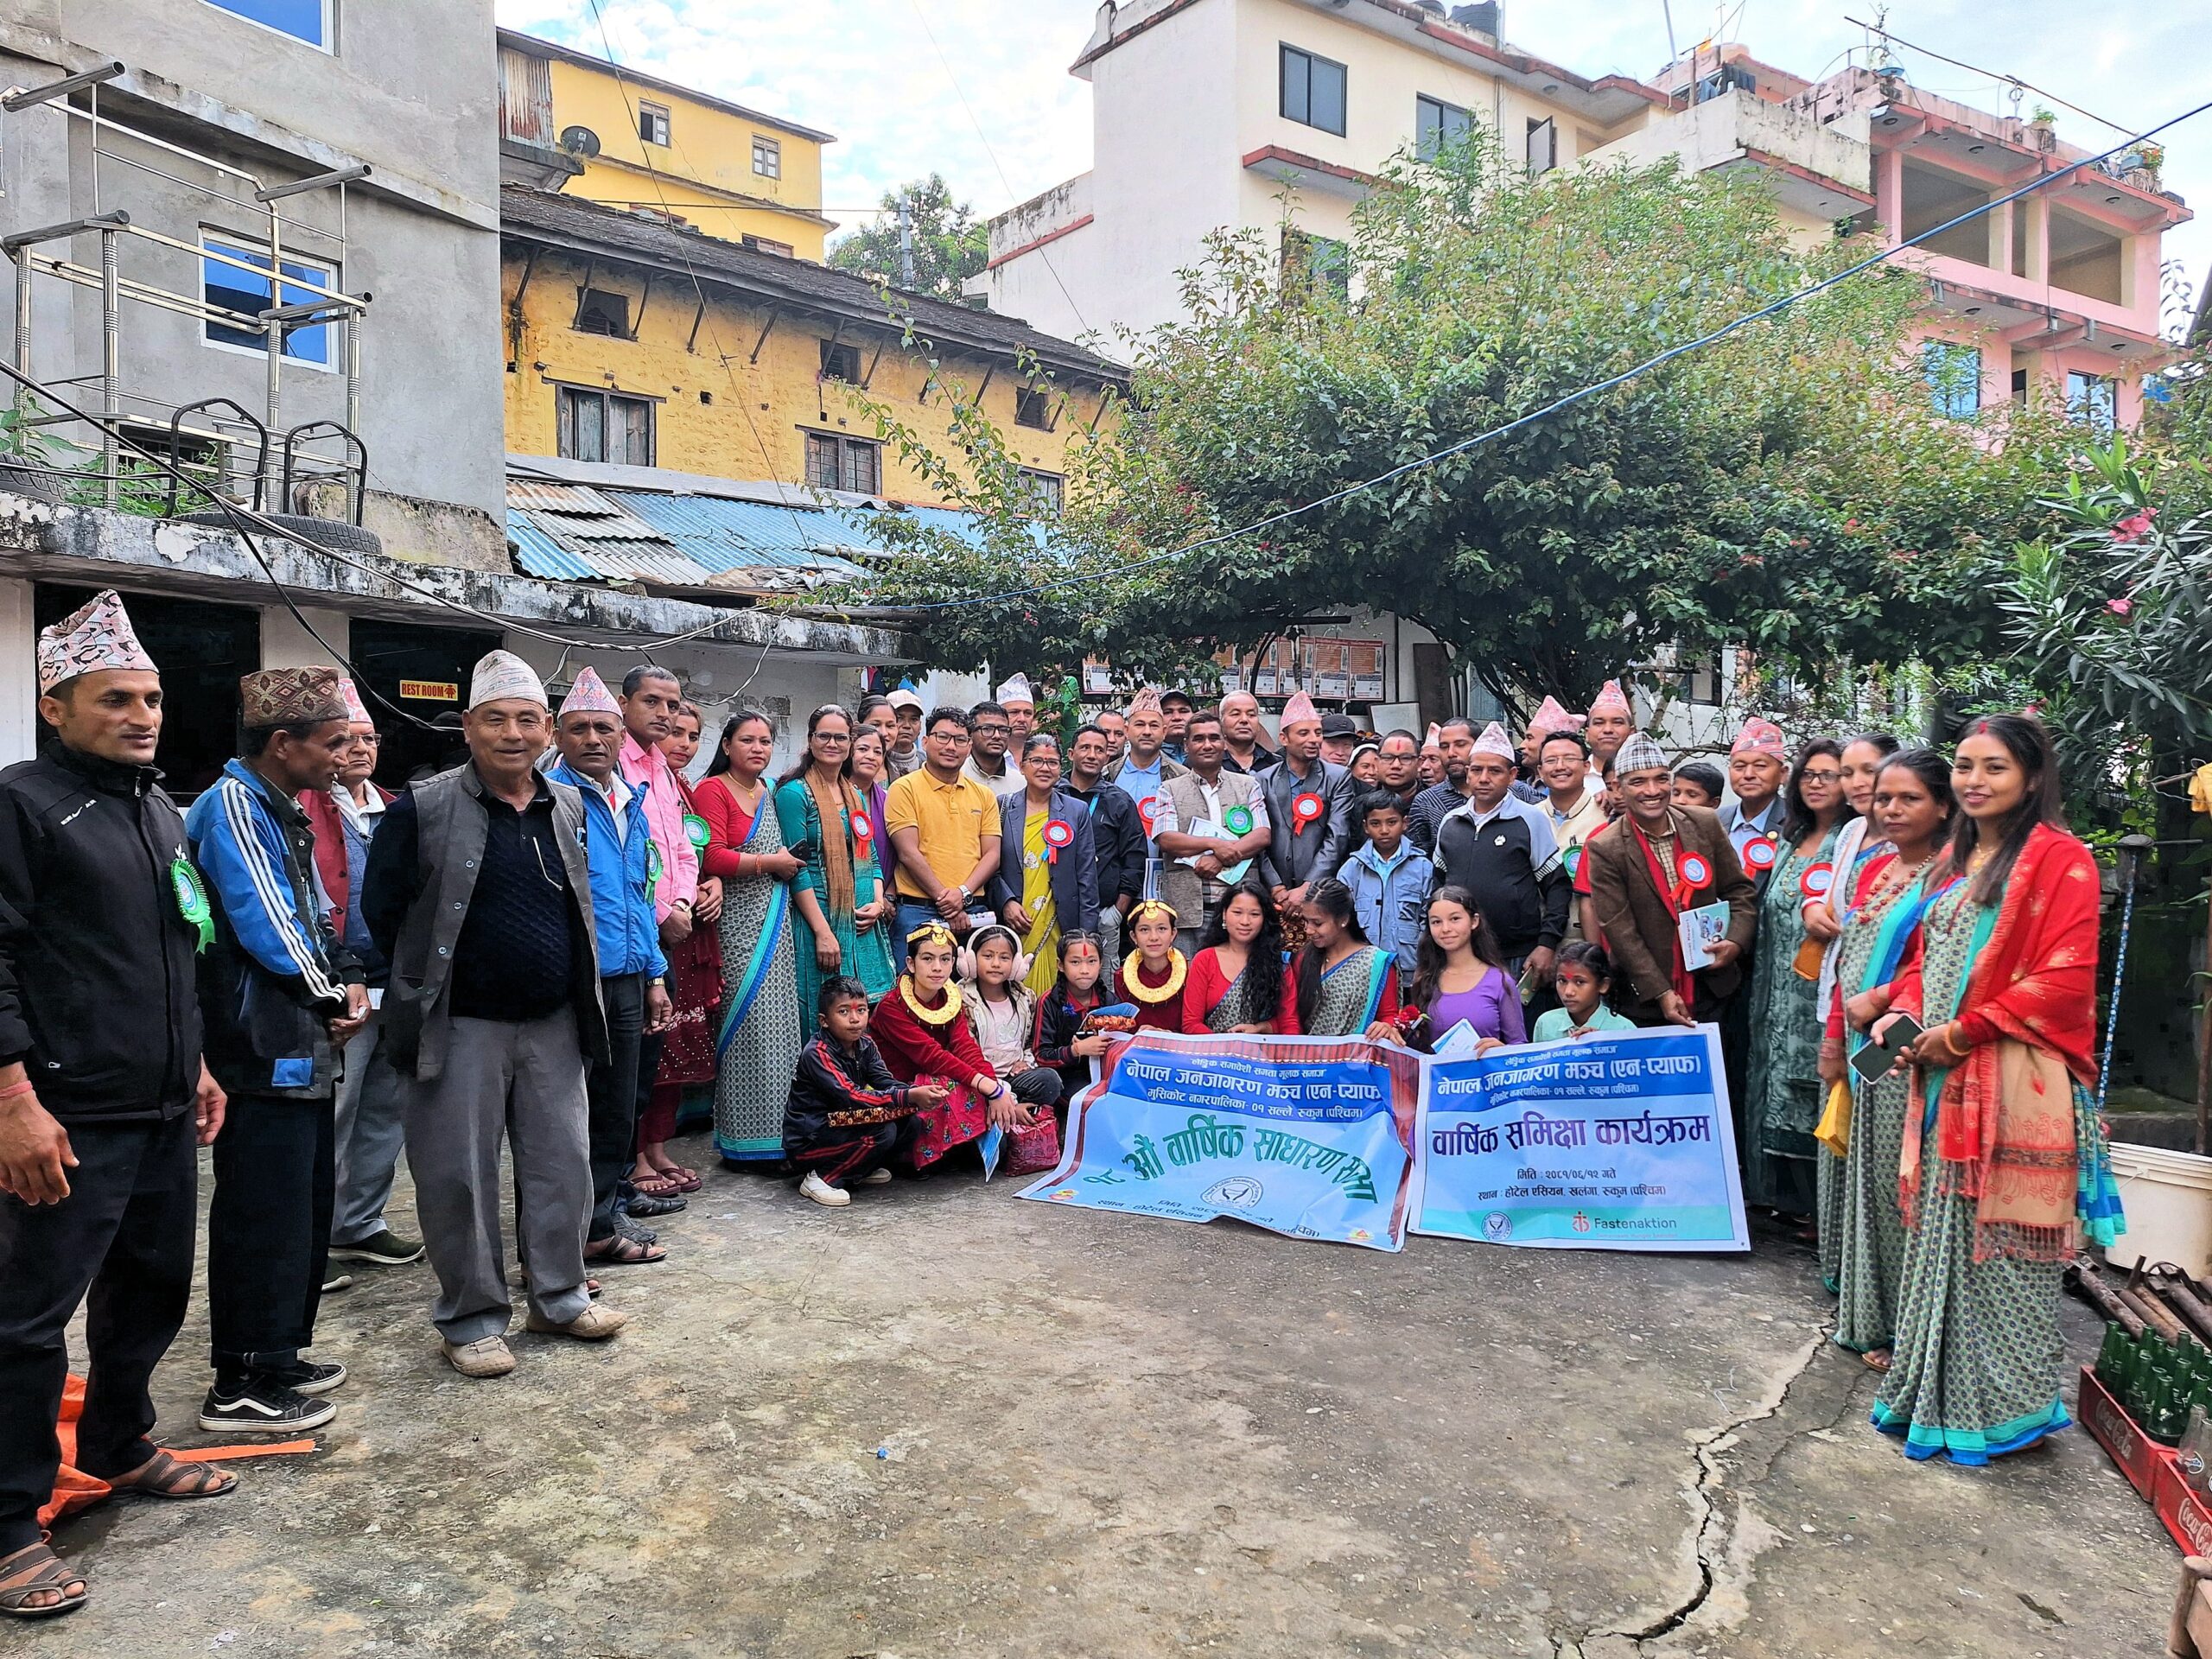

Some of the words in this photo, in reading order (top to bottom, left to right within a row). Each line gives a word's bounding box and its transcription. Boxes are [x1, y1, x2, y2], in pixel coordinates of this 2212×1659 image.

[402, 683, 421, 696] REST
[422, 685, 444, 697] ROOM
[1126, 1058, 1172, 1082] नेपाल
[1175, 1068, 1263, 1096] जनजागरण
[1267, 1084, 1301, 1100] मञ्च
[1219, 1061, 1251, 1074] समावेशी
[1254, 1066, 1277, 1077] समता
[1279, 1069, 1300, 1080] मूलक
[1437, 1076, 1483, 1095] नेपाल
[1484, 1064, 1560, 1091] जनजागरण
[1565, 1061, 1605, 1079] मञ्च
[1610, 1055, 1701, 1079] (एन-प्याफ)
[1554, 1087, 1565, 1096] ०१
[1611, 1082, 1640, 1095] (पश्चिम)
[1147, 1088, 1185, 1103] मुसिकोट
[1251, 1103, 1264, 1113] ०१
[1326, 1105, 1363, 1120] (पश्चिम)
[1432, 1121, 1499, 1156] वार्षिक
[1504, 1111, 1586, 1150] समिक्षा
[1594, 1109, 1711, 1146] कार्यक्रम
[1162, 1114, 1247, 1166] वार्षिक
[1253, 1127, 1349, 1177] साधारण
[1332, 1155, 1379, 1204] सभा
[1517, 1167, 1537, 1180] मिति
[1545, 1170, 1599, 1180] २०८१/०६/१२
[1602, 1167, 1617, 1179] गते
[1478, 1190, 1497, 1201] स्थान
[1504, 1185, 1529, 1198] होटेल
[1630, 1183, 1667, 1197] (पश्चिम)
[1594, 1217, 1677, 1229] Fastenaktion
